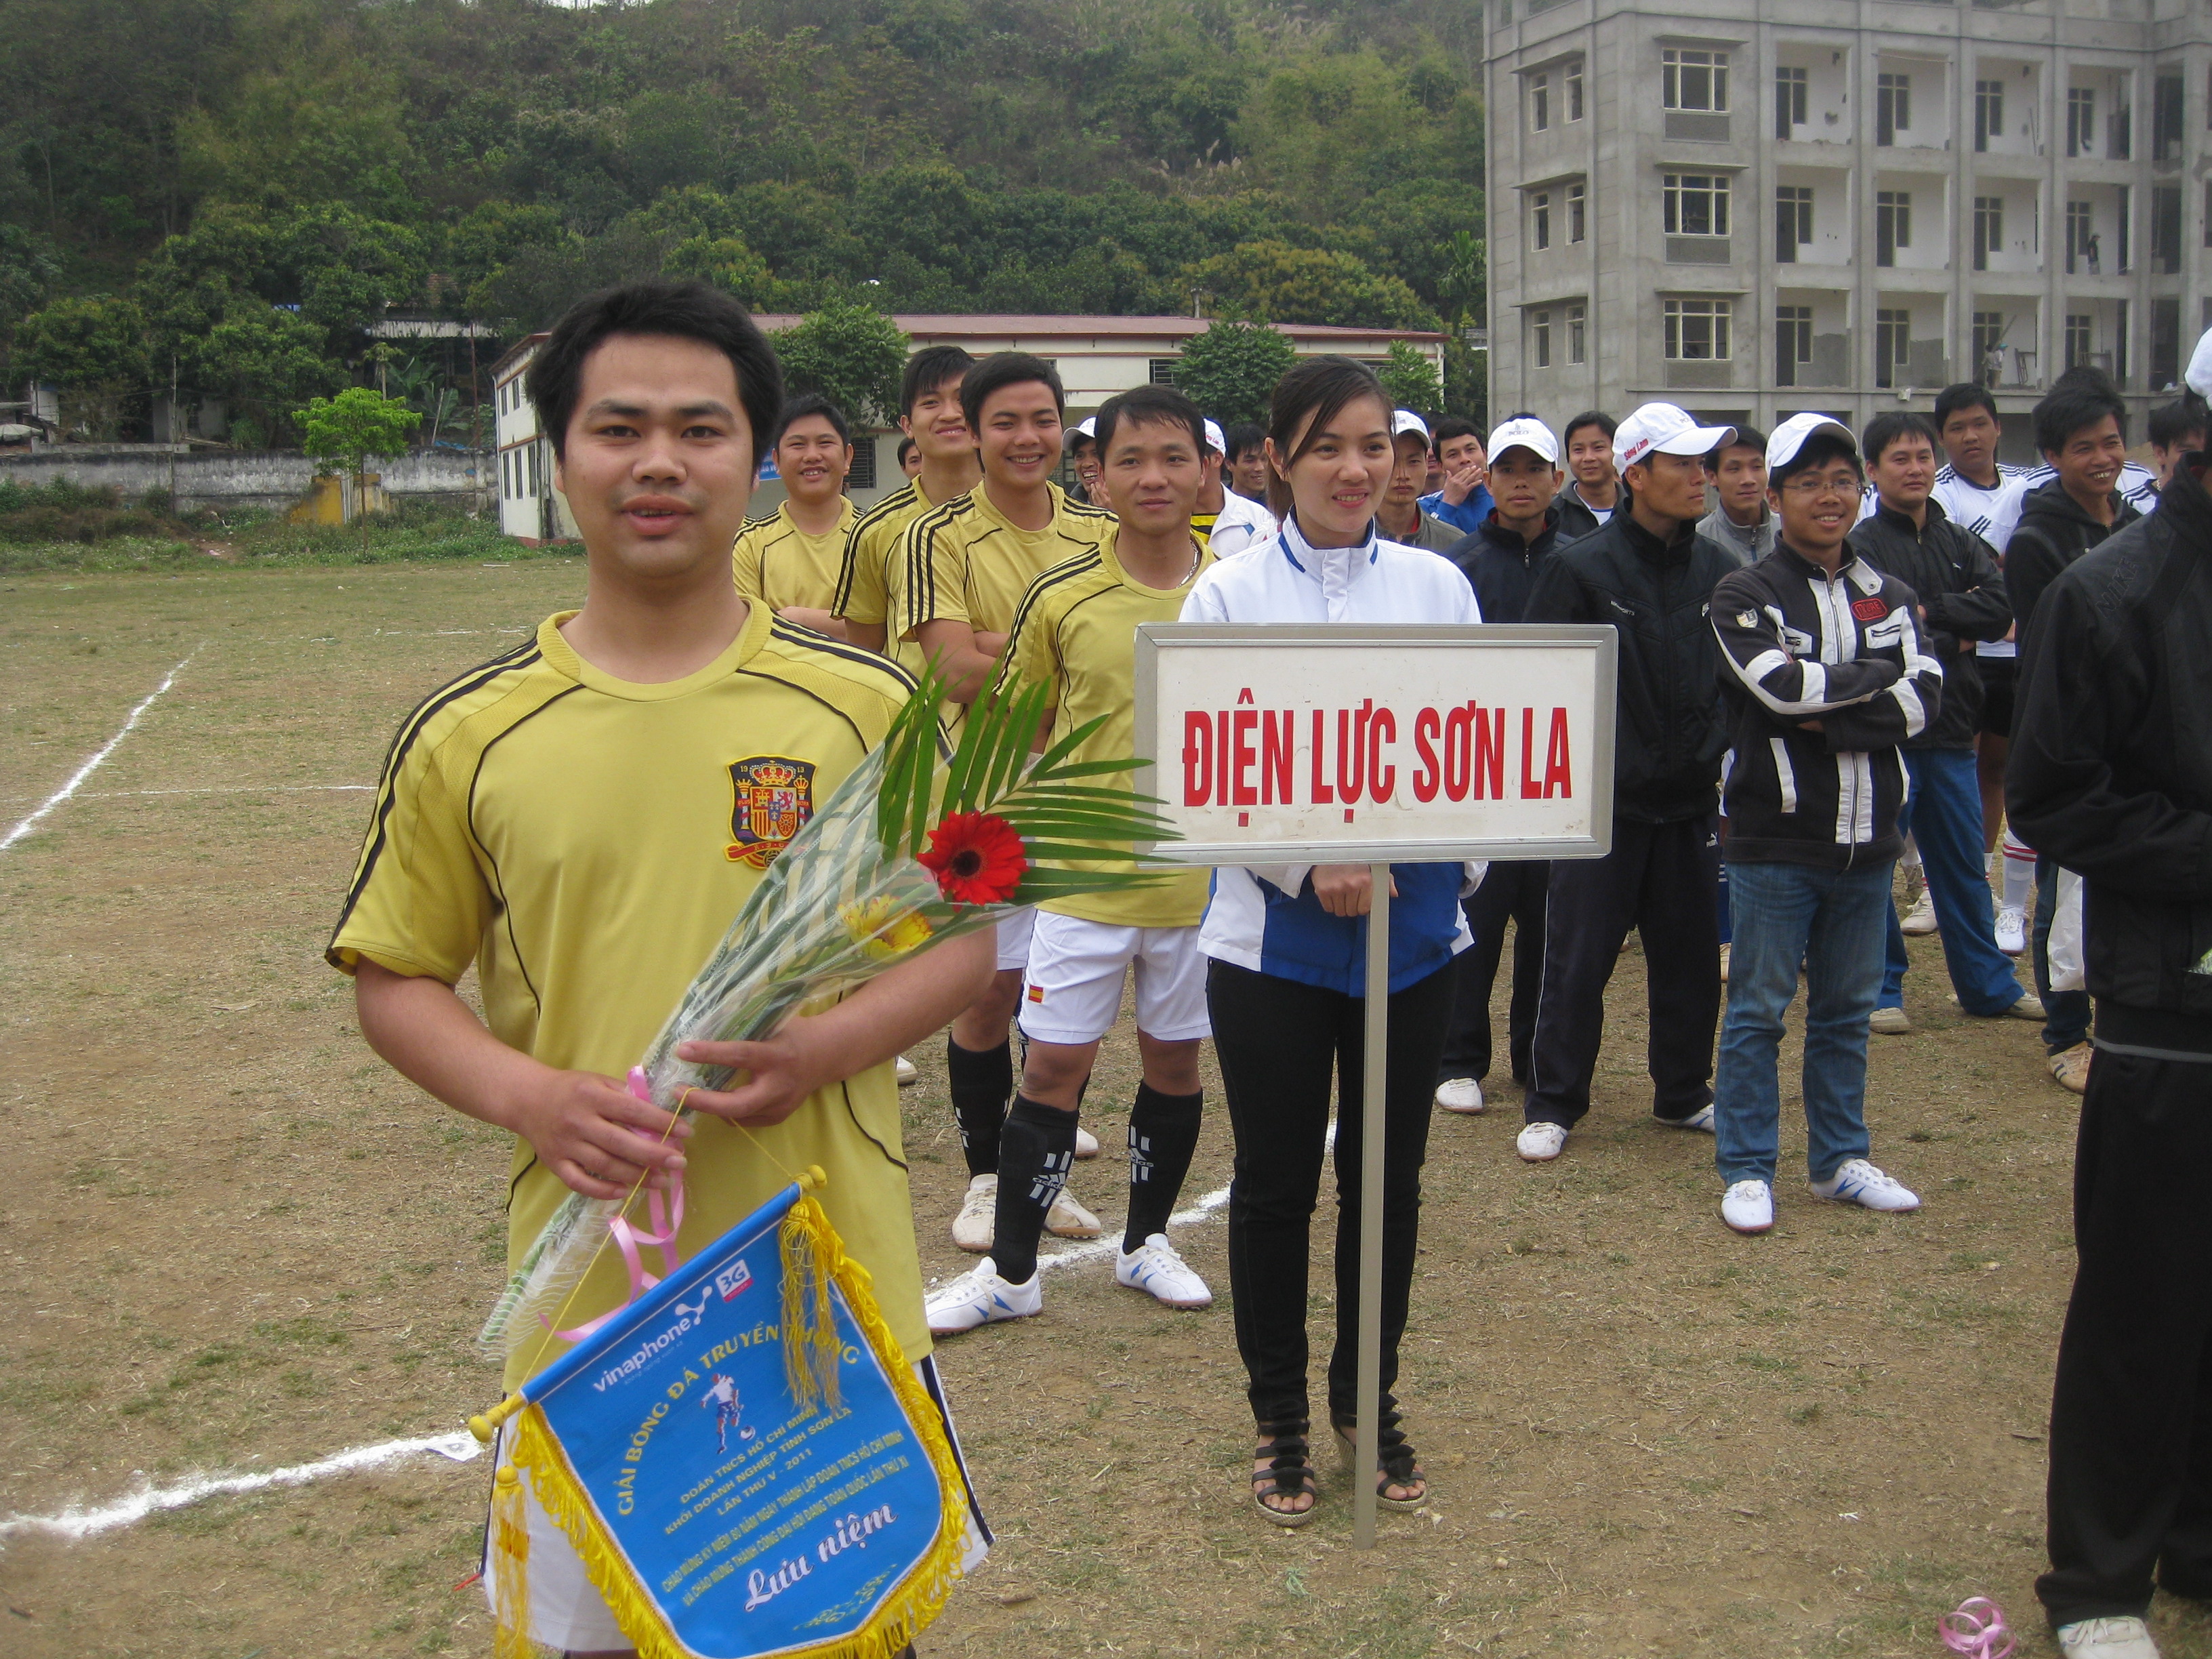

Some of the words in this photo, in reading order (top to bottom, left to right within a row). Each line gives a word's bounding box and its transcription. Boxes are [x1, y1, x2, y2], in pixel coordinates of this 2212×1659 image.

[1182, 687, 1294, 827] ĐIỆN
[1311, 698, 1397, 824] LỰC
[1413, 699, 1506, 803] SƠN
[1520, 707, 1572, 800] LA
[720, 1266, 746, 1292] 3G
[593, 1317, 691, 1392] vinaphone
[613, 1467, 637, 1515] GIẢI
[626, 1401, 670, 1462] BÓNG
[667, 1366, 700, 1399] ĐÁ
[699, 1321, 779, 1370] TRUYỀN
[680, 1475, 714, 1504] ĐOÀN
[715, 1453, 746, 1478] TNCS
[747, 1437, 765, 1456] HỒ
[765, 1424, 787, 1443] CHÍ
[693, 1480, 735, 1513] DOANH
[735, 1450, 778, 1483] NGHIỆP
[767, 1471, 777, 1481] V
[785, 1448, 812, 1471] 2011
[744, 1554, 815, 1612] Lưu
[817, 1503, 899, 1563] niệm
